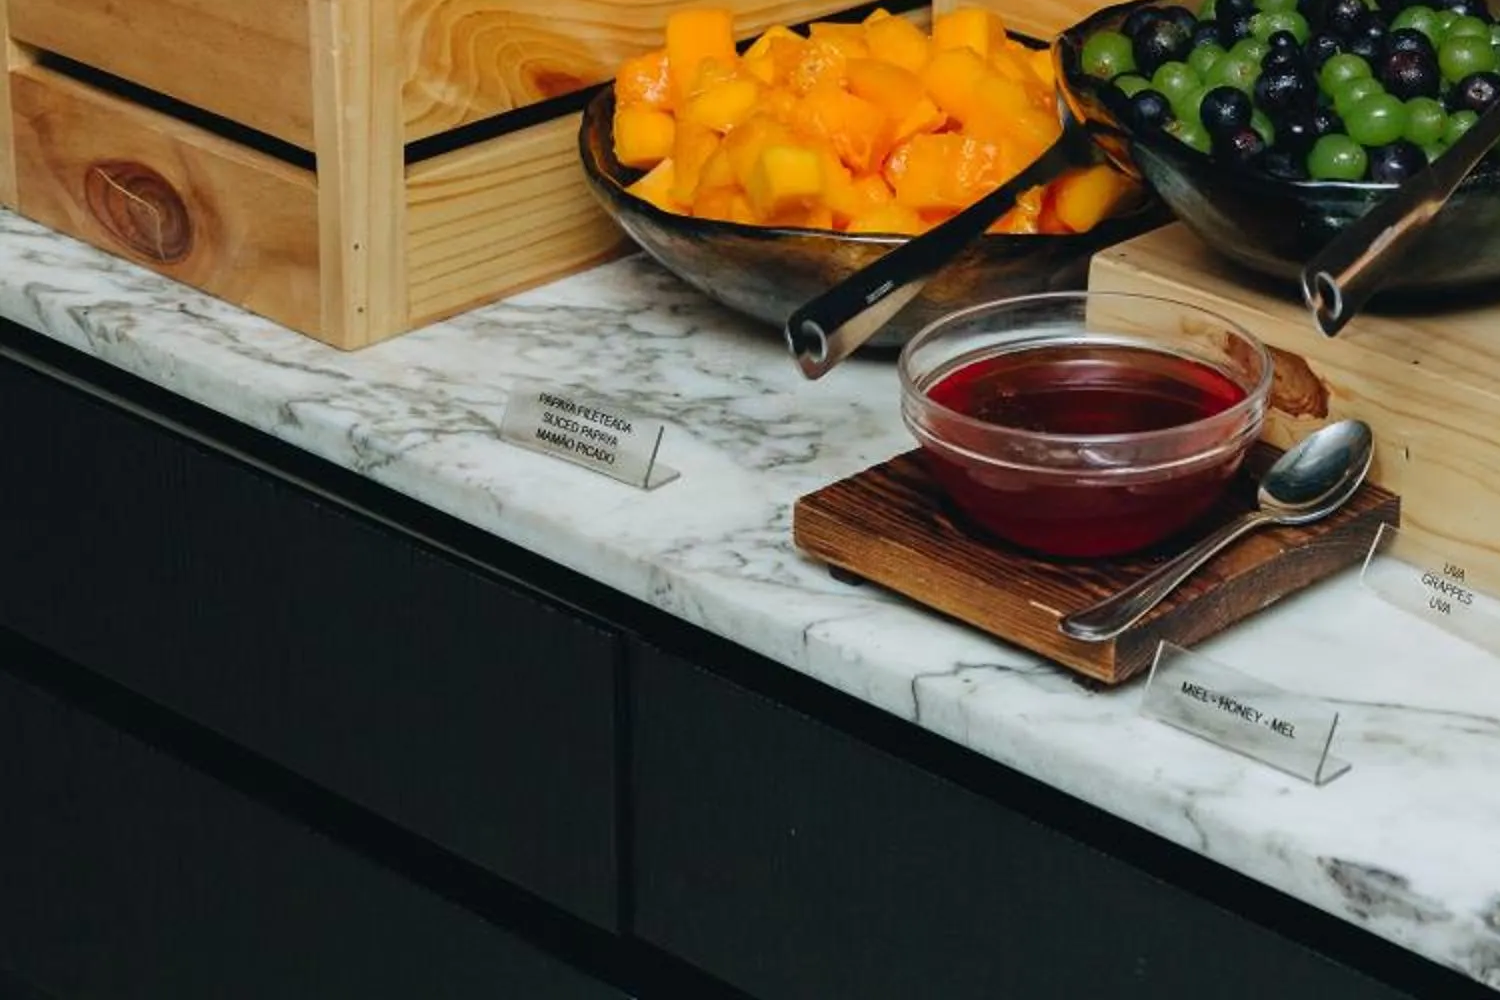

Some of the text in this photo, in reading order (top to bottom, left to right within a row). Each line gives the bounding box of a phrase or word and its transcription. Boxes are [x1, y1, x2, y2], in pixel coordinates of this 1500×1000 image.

[542, 411, 619, 447] SLICED PAPAYA
[576, 405, 633, 434] FILETEADA
[535, 427, 615, 465] MAMÃO PICADO
[1443, 561, 1465, 582] UVA
[1421, 573, 1473, 605] GRAPPES
[1429, 596, 1451, 615] UVA
[1181, 681, 1208, 703] MIEL
[1218, 695, 1263, 725] HONEY
[1270, 718, 1296, 739] MEL
